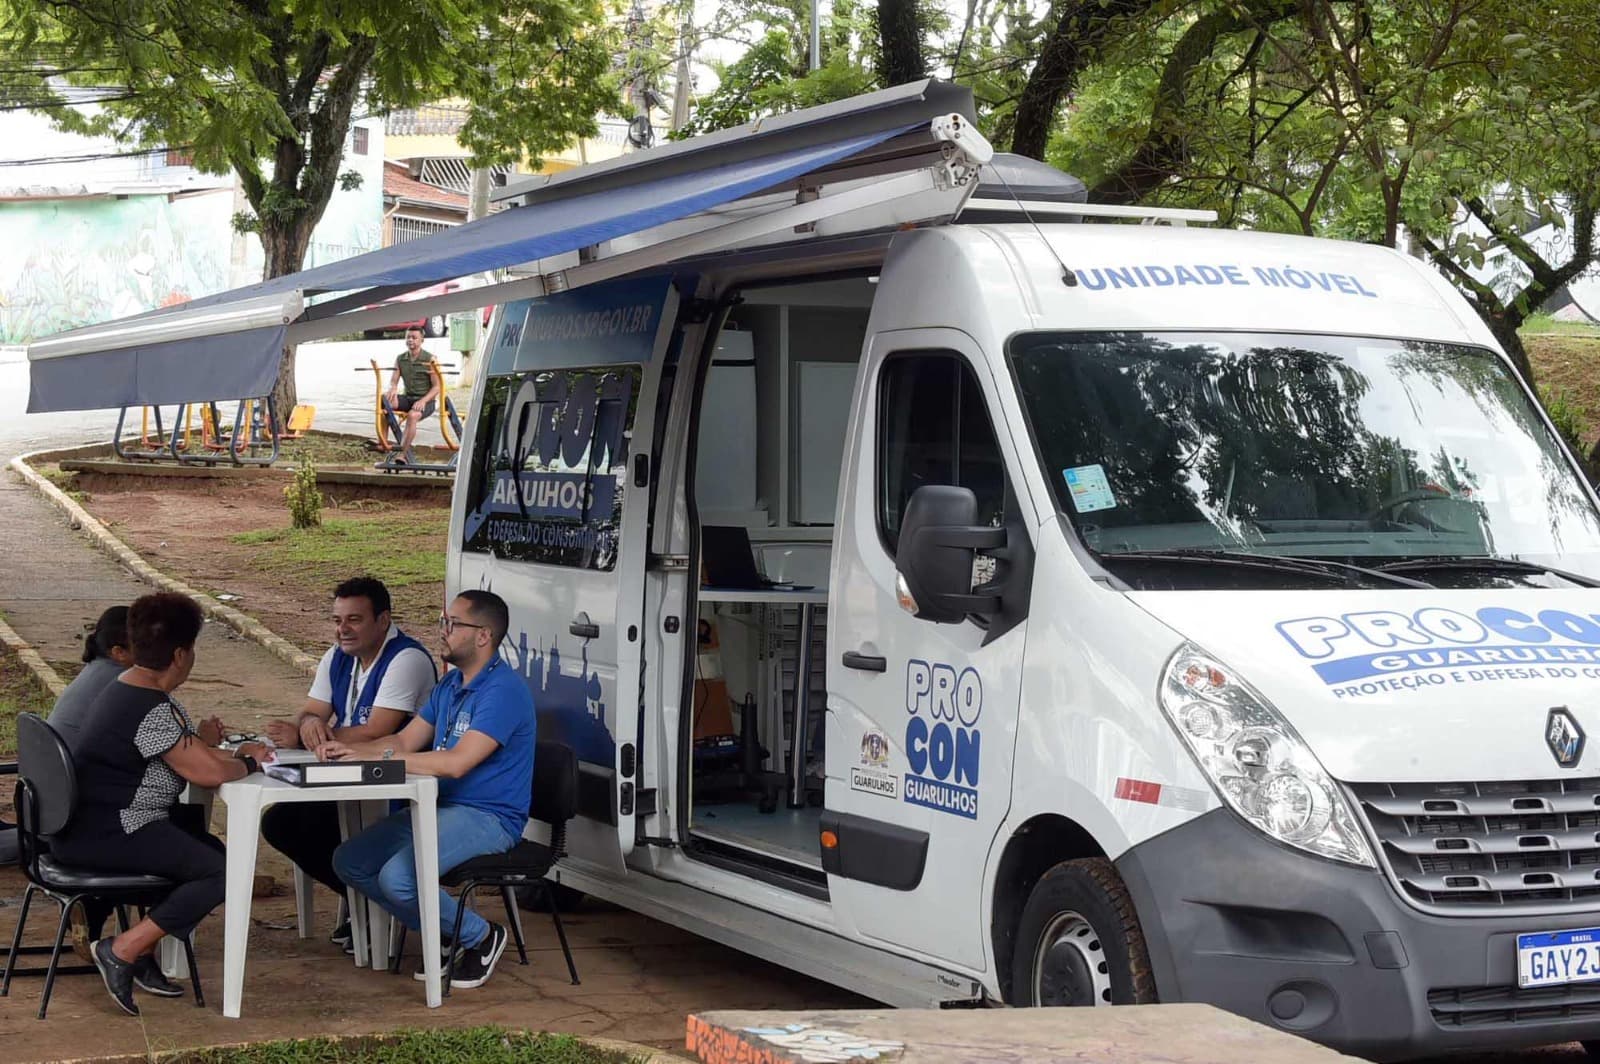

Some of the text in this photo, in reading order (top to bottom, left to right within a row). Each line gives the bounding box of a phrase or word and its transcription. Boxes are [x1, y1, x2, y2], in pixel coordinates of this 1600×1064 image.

[1075, 264, 1378, 298] UNIDADE MÓVEL
[1274, 607, 1600, 659] PROCO
[906, 658, 983, 728] PRO
[1331, 672, 1446, 699] PROTEÇÃO
[1450, 671, 1466, 683] E
[1468, 667, 1545, 683] DEFESA
[1546, 667, 1577, 679] DO
[905, 716, 981, 788] CON
[853, 775, 895, 793] GUARULHOS
[904, 779, 977, 815] GUARULHOS
[1571, 934, 1593, 943] BRASIL
